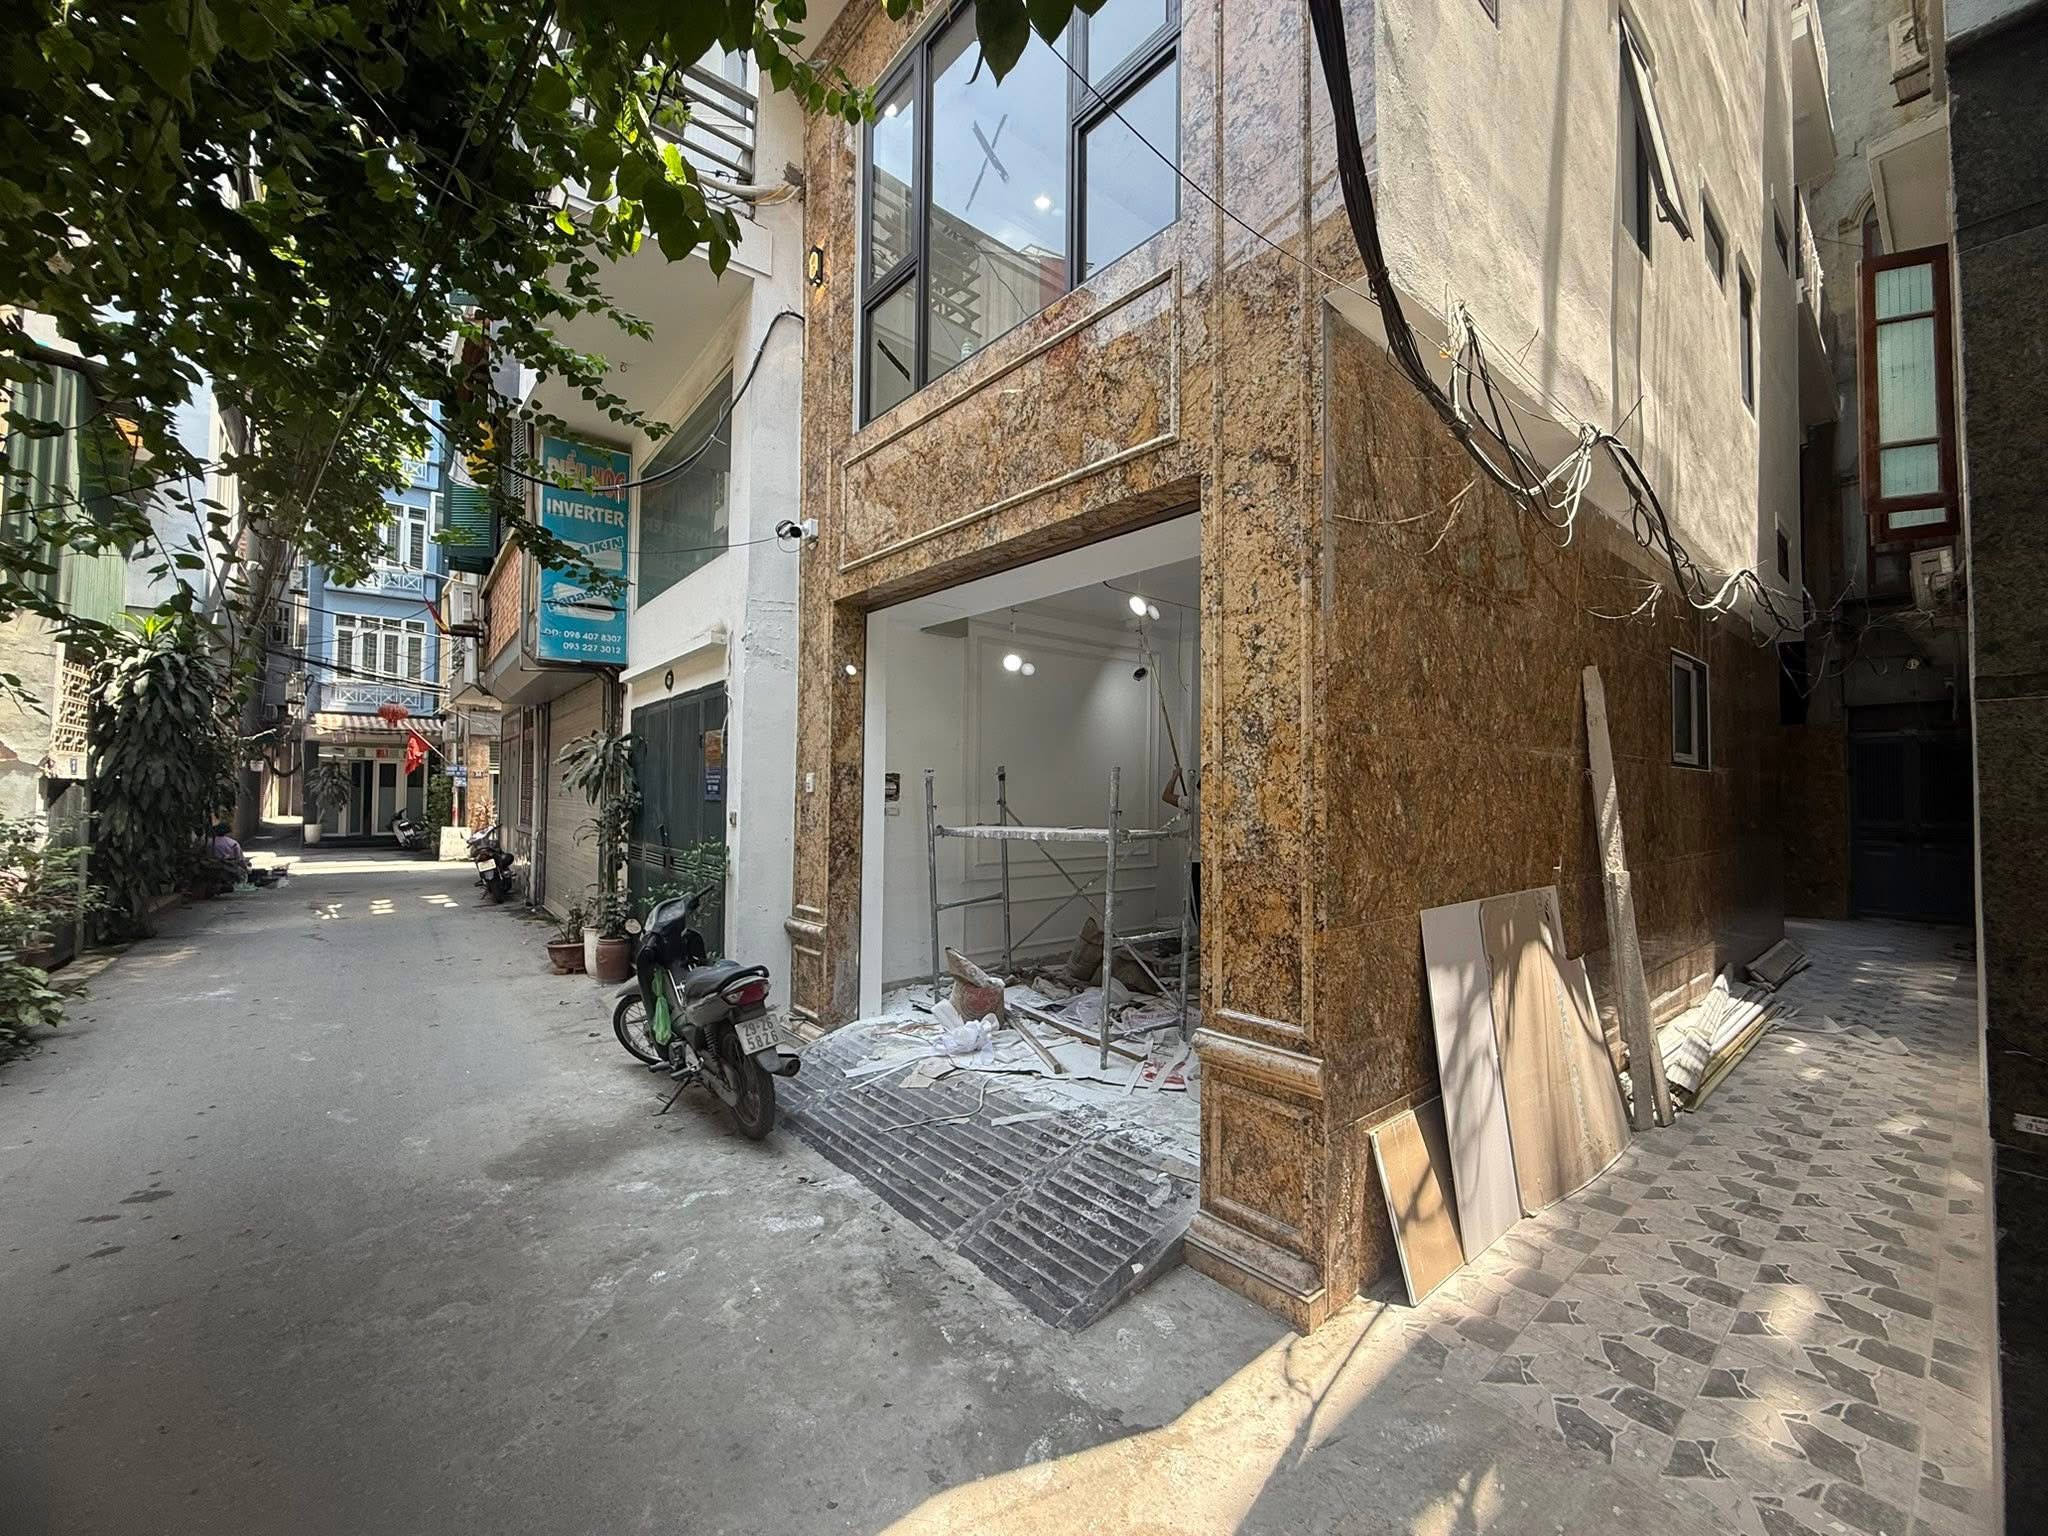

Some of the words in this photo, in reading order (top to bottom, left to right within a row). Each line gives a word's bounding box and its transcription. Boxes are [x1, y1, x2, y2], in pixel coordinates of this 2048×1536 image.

[546, 498, 625, 528] INVERTER
[582, 632, 599, 640] 407
[600, 634, 622, 643] 8307
[562, 641, 580, 650] 093
[582, 643, 598, 652] 227
[600, 645, 621, 654] 3012
[746, 1030, 779, 1050] 5826
